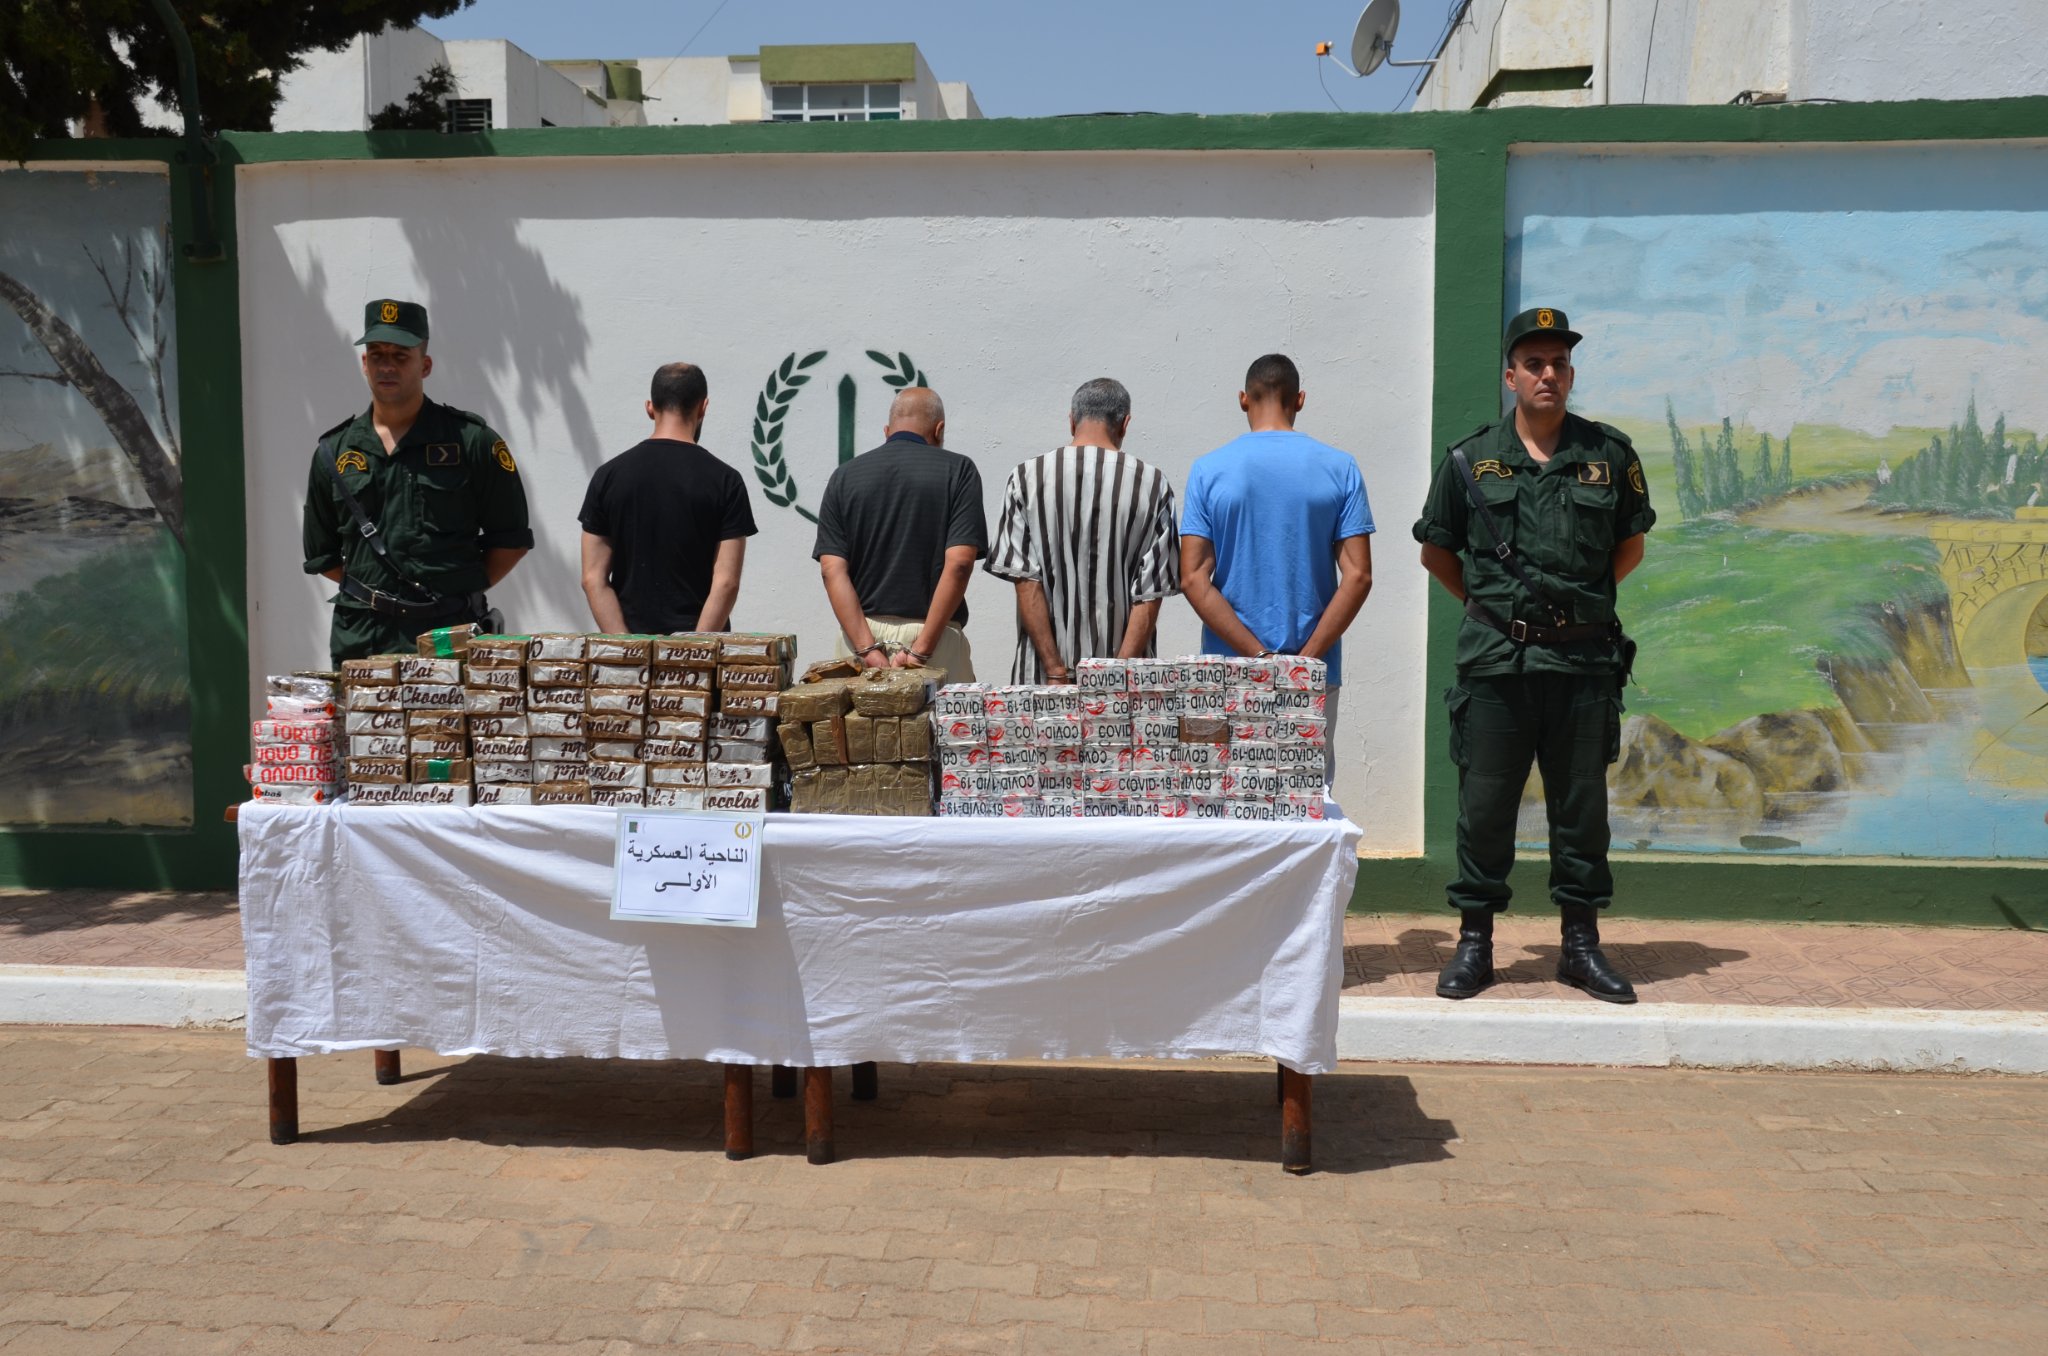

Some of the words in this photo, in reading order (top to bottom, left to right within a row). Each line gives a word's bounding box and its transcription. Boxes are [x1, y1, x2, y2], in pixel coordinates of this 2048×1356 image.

[478, 787, 500, 804] lat
[708, 791, 760, 809] ocolat
[627, 840, 693, 862] العسكرية
[699, 843, 748, 865] الناحية
